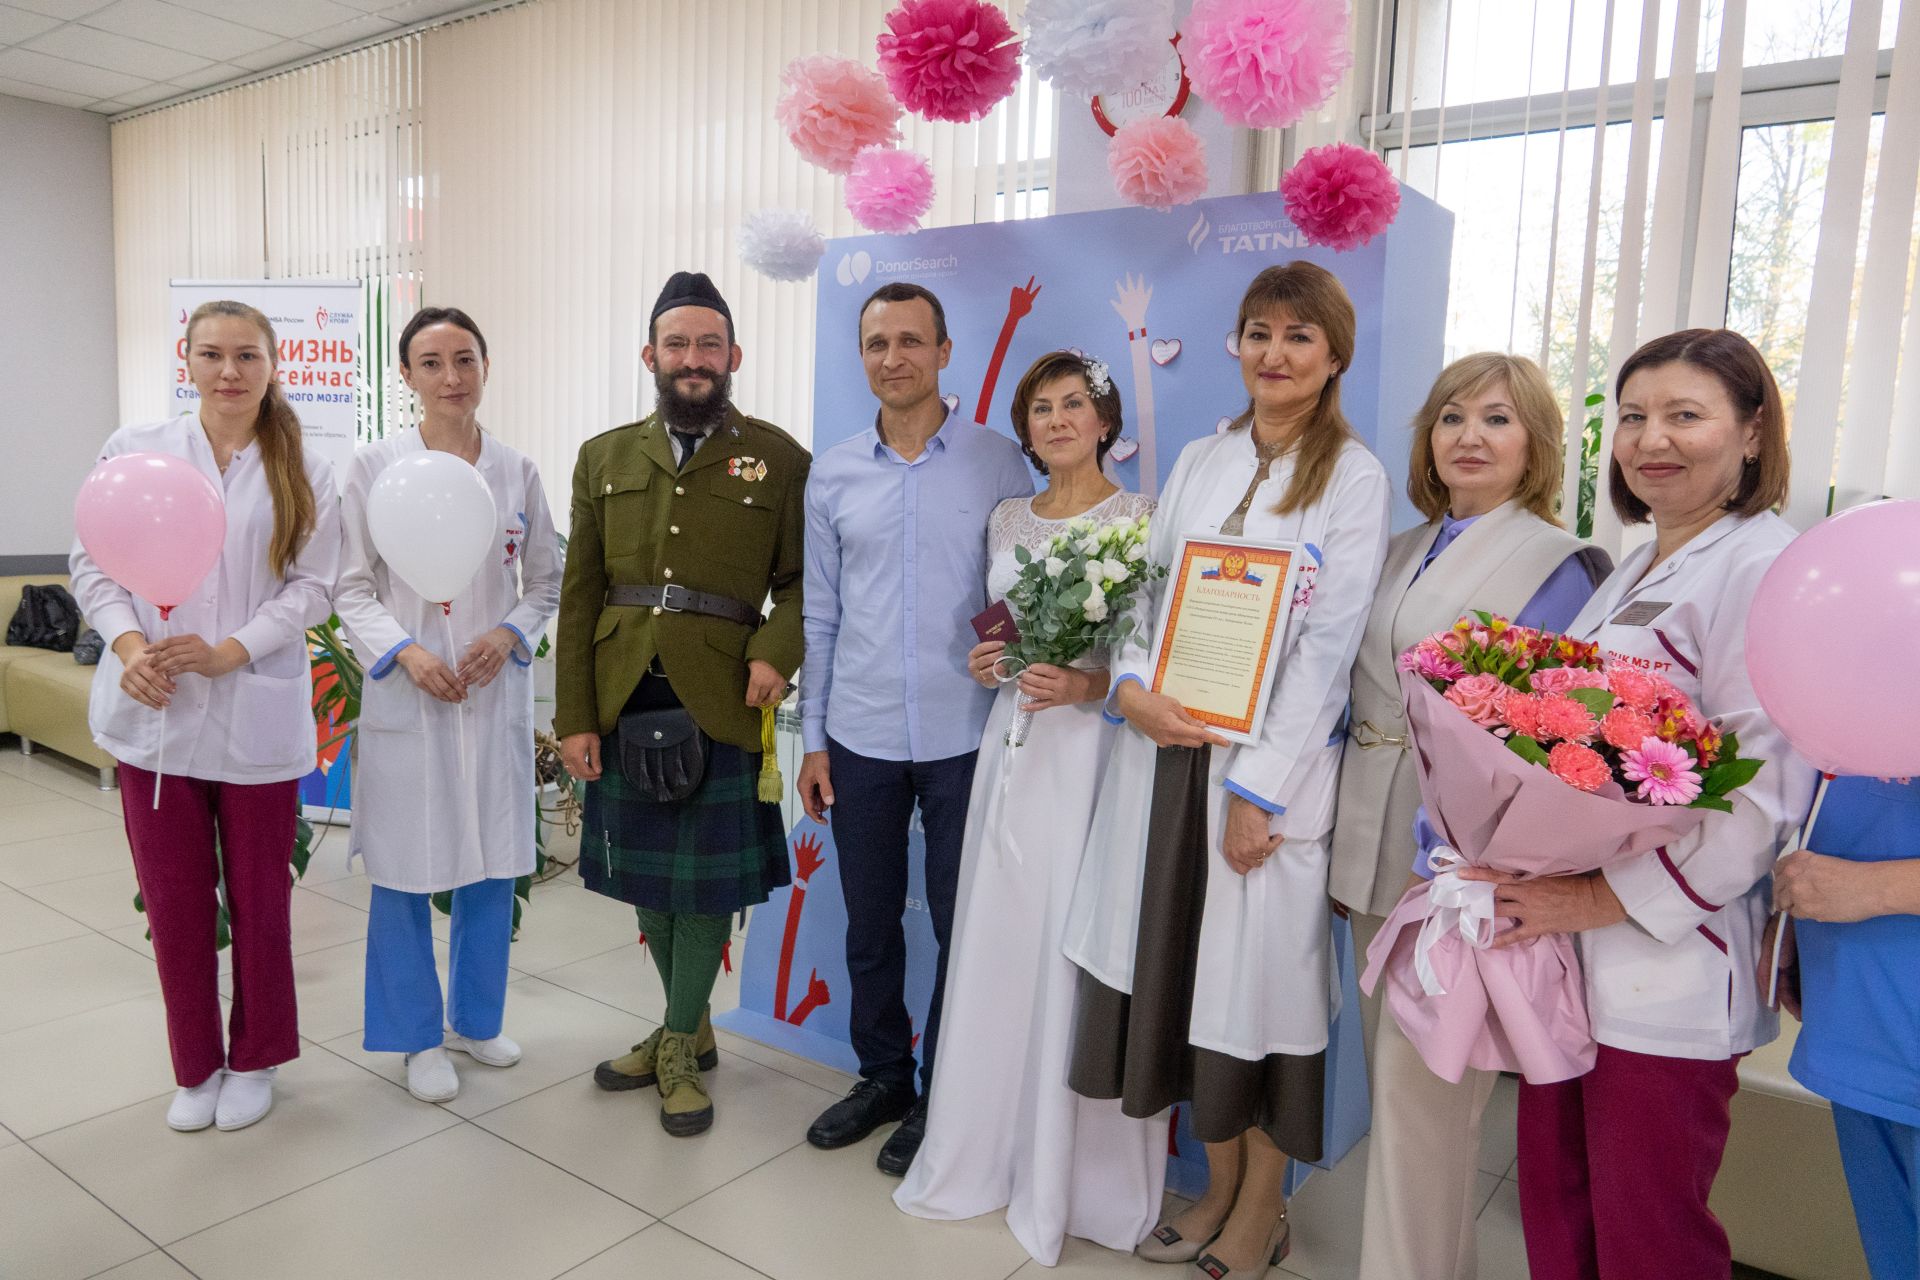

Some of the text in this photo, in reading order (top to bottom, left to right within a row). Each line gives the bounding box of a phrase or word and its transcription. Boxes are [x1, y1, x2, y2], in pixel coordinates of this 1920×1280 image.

[1174, 72, 1180, 81] 3
[1218, 230, 1310, 255] TATNE
[875, 254, 958, 274] DonorSearch
[283, 316, 305, 324] России
[176, 387, 200, 399] Стан
[284, 392, 354, 404] ного мозга!
[1632, 656, 1651, 670] МЗ
[1653, 661, 1672, 672] РТ
